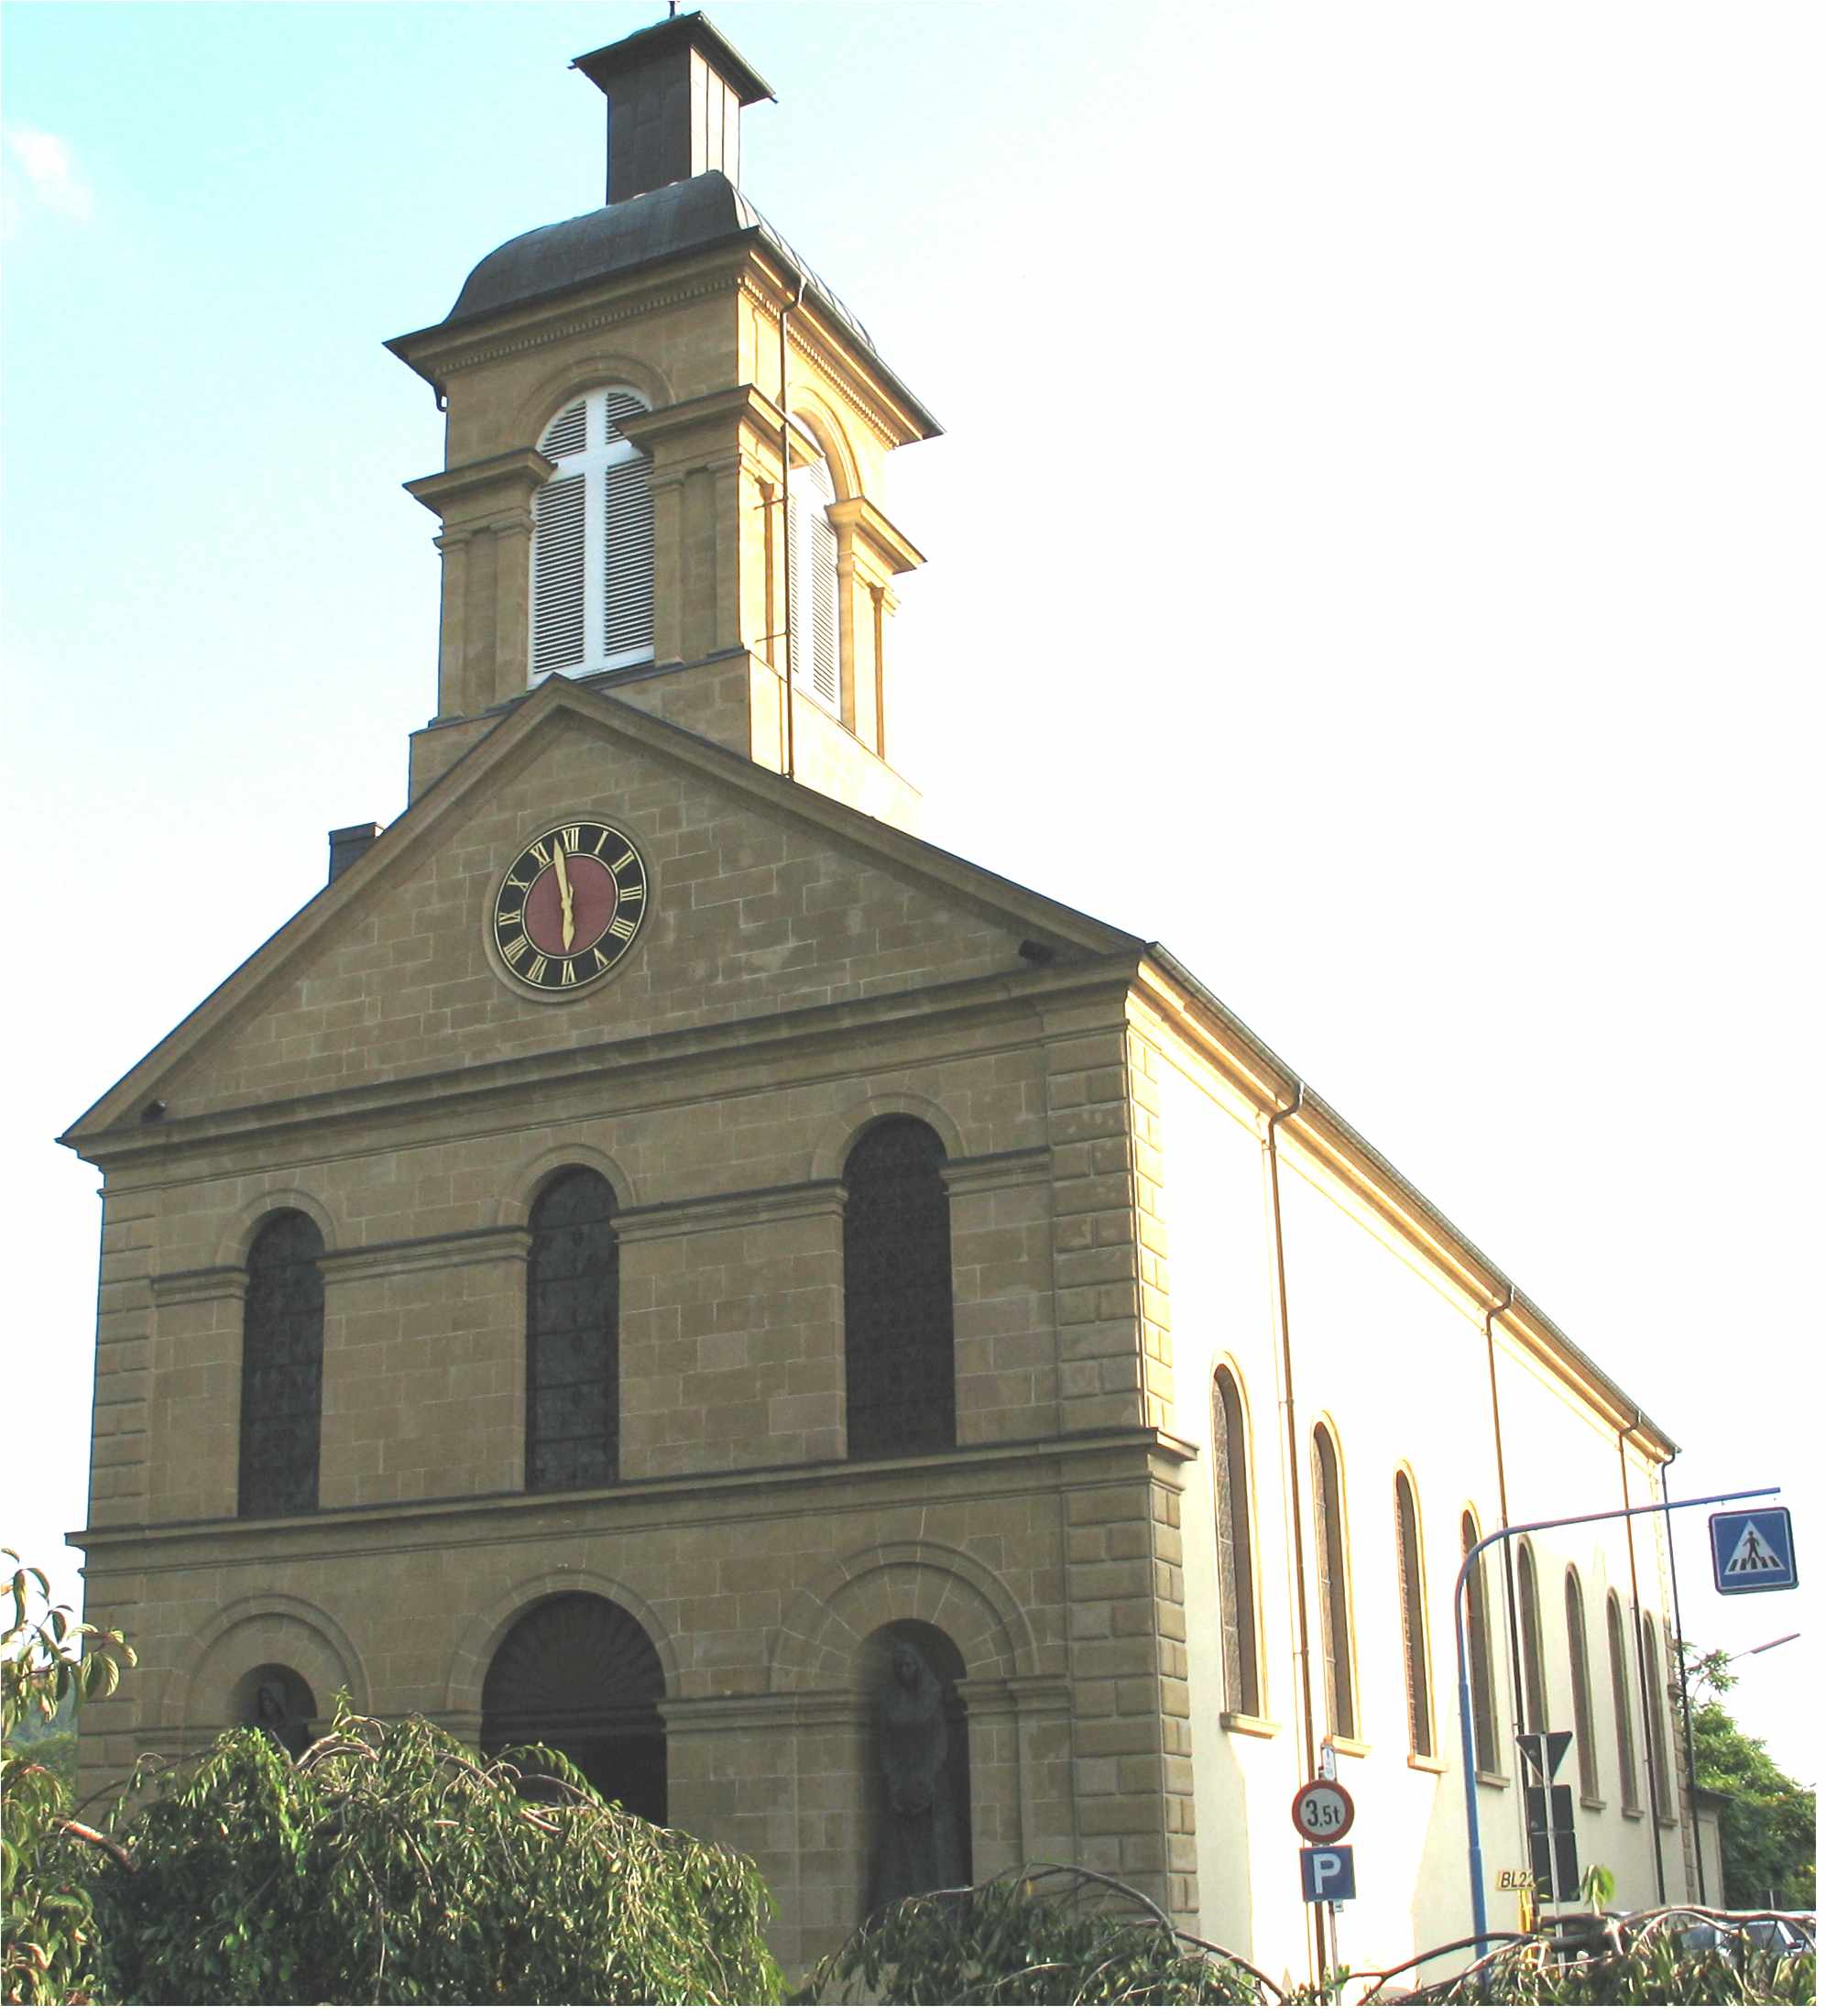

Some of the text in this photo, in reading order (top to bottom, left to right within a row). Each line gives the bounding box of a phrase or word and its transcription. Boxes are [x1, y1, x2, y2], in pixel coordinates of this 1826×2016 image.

[562, 827, 581, 852] XII
[594, 830, 609, 856] I
[529, 841, 552, 869] XI
[611, 849, 636, 874] II
[507, 874, 530, 893] X
[619, 885, 642, 903] III
[608, 916, 637, 942] IIII
[593, 948, 611, 970] V
[1313, 1853, 1342, 1895] P
